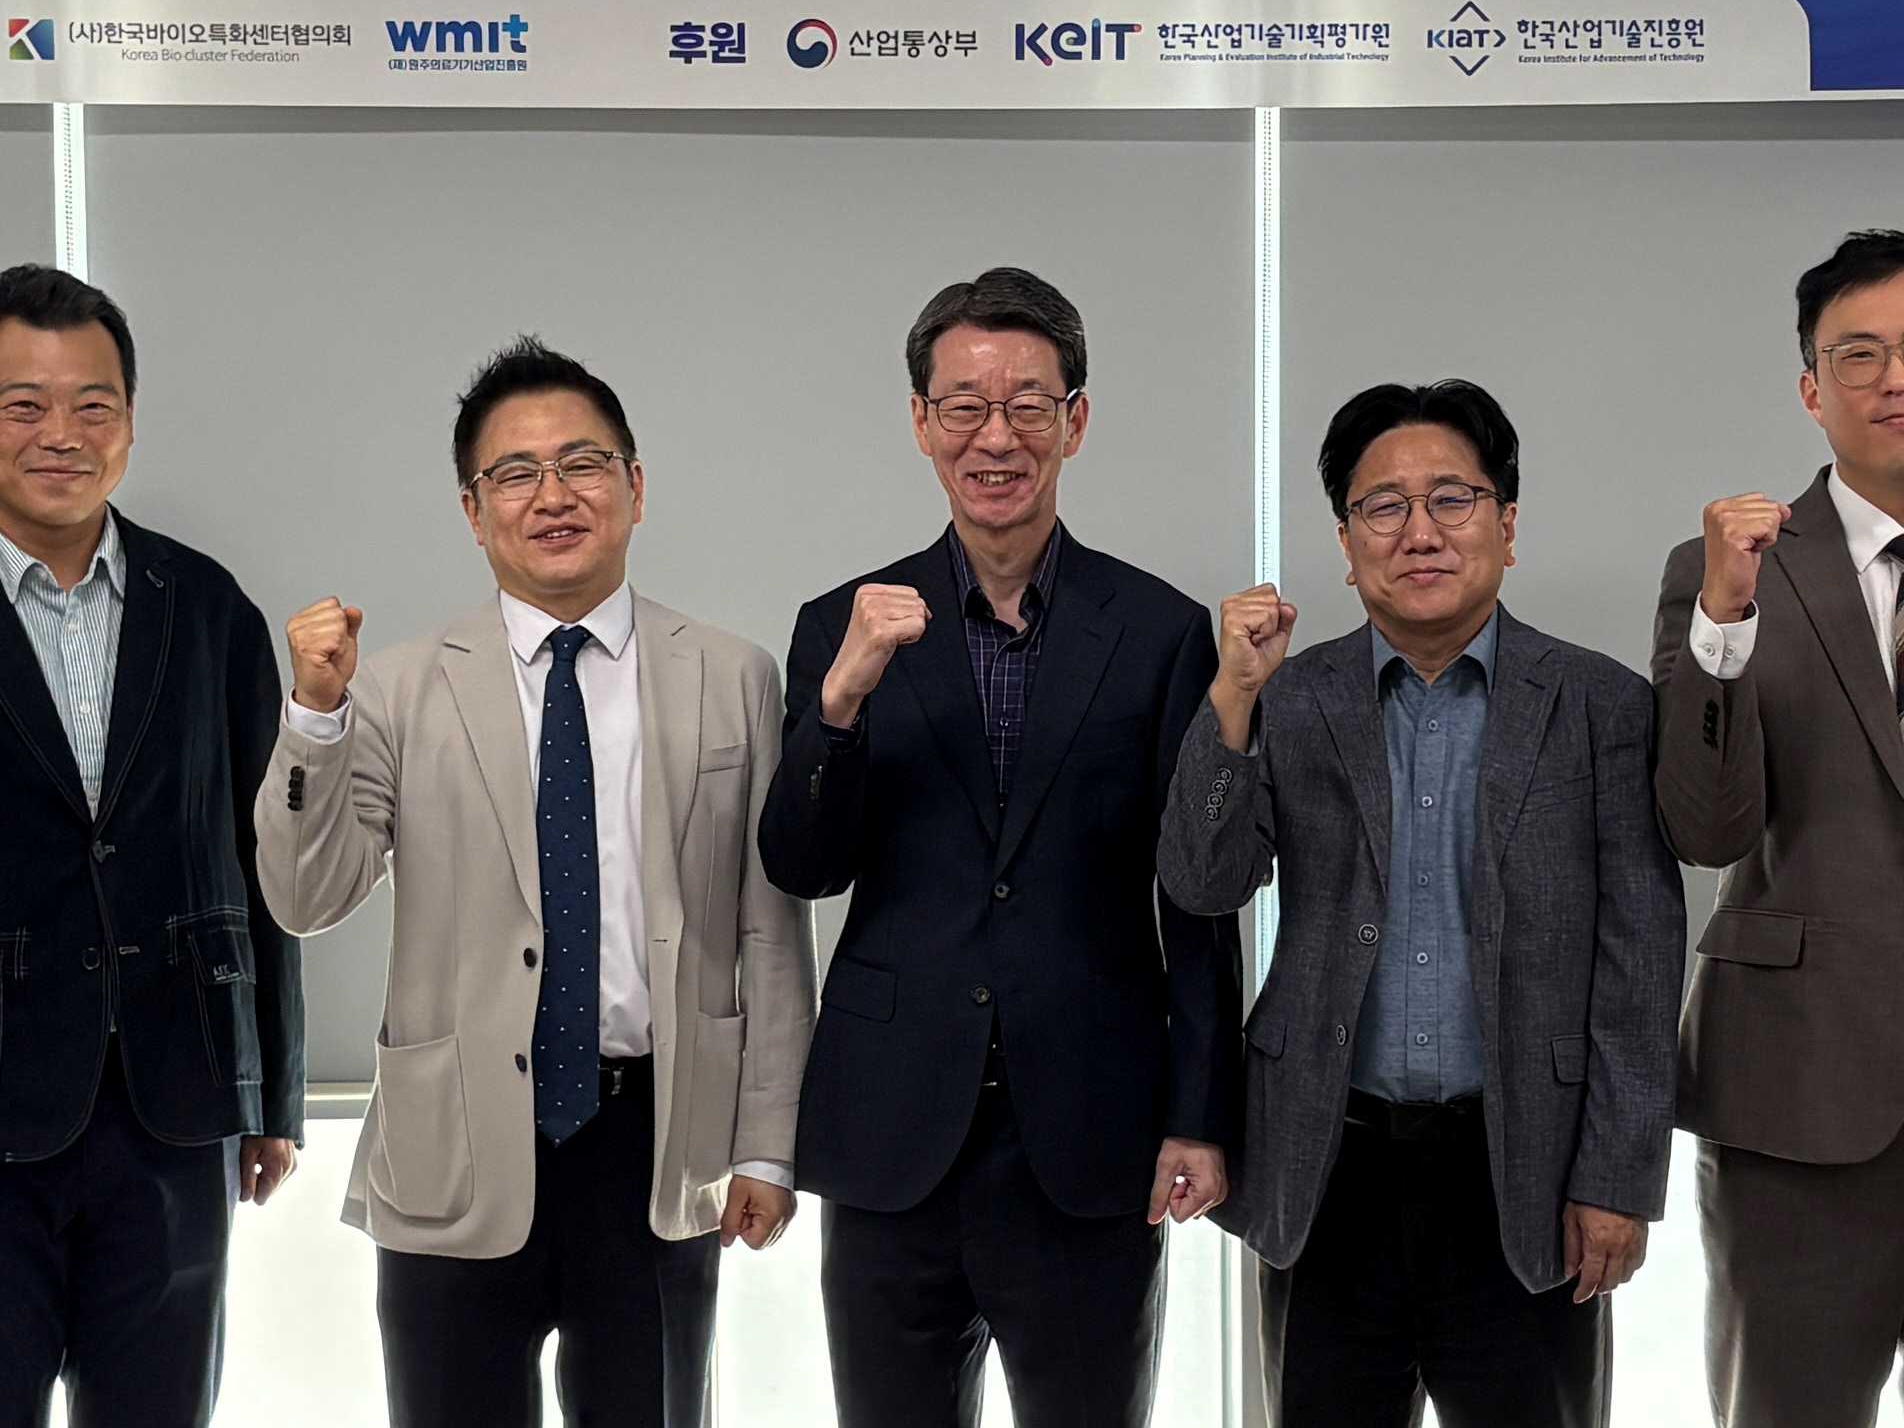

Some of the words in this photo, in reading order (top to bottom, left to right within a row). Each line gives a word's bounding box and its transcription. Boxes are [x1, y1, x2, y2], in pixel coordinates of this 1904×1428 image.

[385, 14, 529, 54] wmit
[669, 21, 746, 65] 후원
[849, 29, 978, 58] 산업통상부
[1157, 23, 1390, 49] 한국산업기술기획평가원
[1516, 18, 1705, 50] 한국산업기술진흥원
[121, 49, 159, 61] Korea
[161, 49, 183, 61] Bio
[230, 49, 300, 62] Federation
